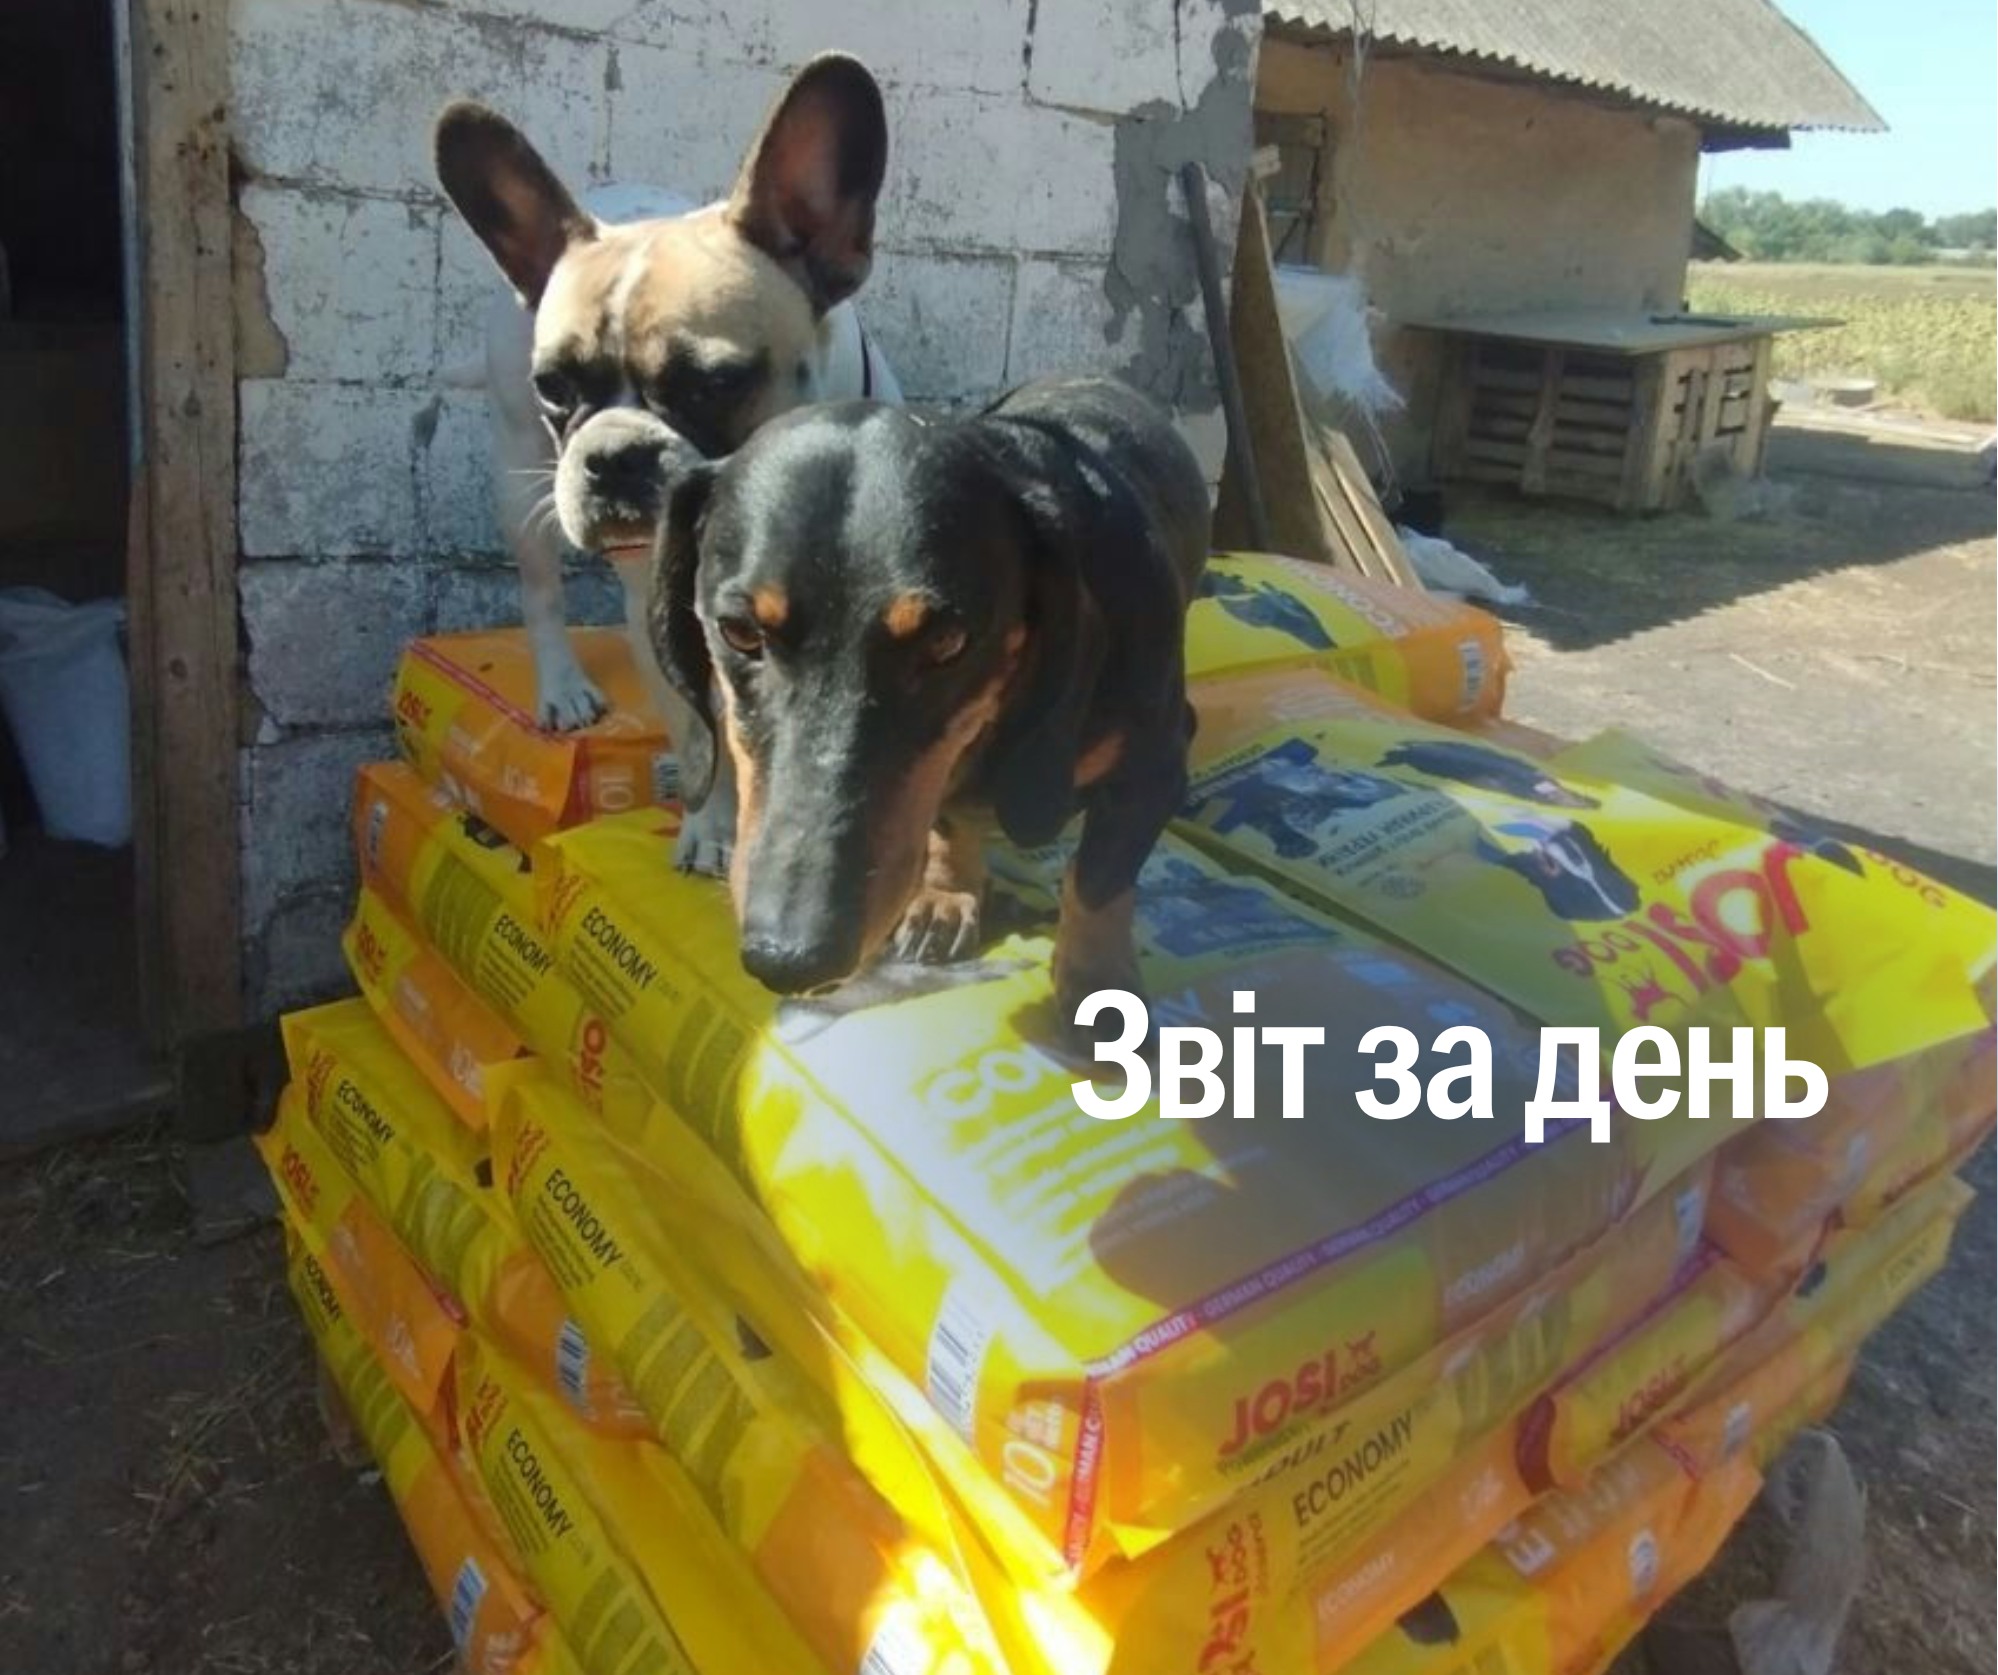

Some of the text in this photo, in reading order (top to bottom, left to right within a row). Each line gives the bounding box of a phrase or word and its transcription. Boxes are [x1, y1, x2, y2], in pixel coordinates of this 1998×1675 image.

[495, 914, 553, 977] ECONOMY
[582, 906, 657, 990] ECONOMY
[1554, 931, 1641, 978] DOG
[336, 1079, 396, 1143] ECONOMY
[546, 1168, 623, 1268] ECONOMY
[1217, 1349, 1337, 1457] JOSI
[507, 1427, 574, 1539] ECONOMY
[1292, 1409, 1413, 1528] ECONOMY
